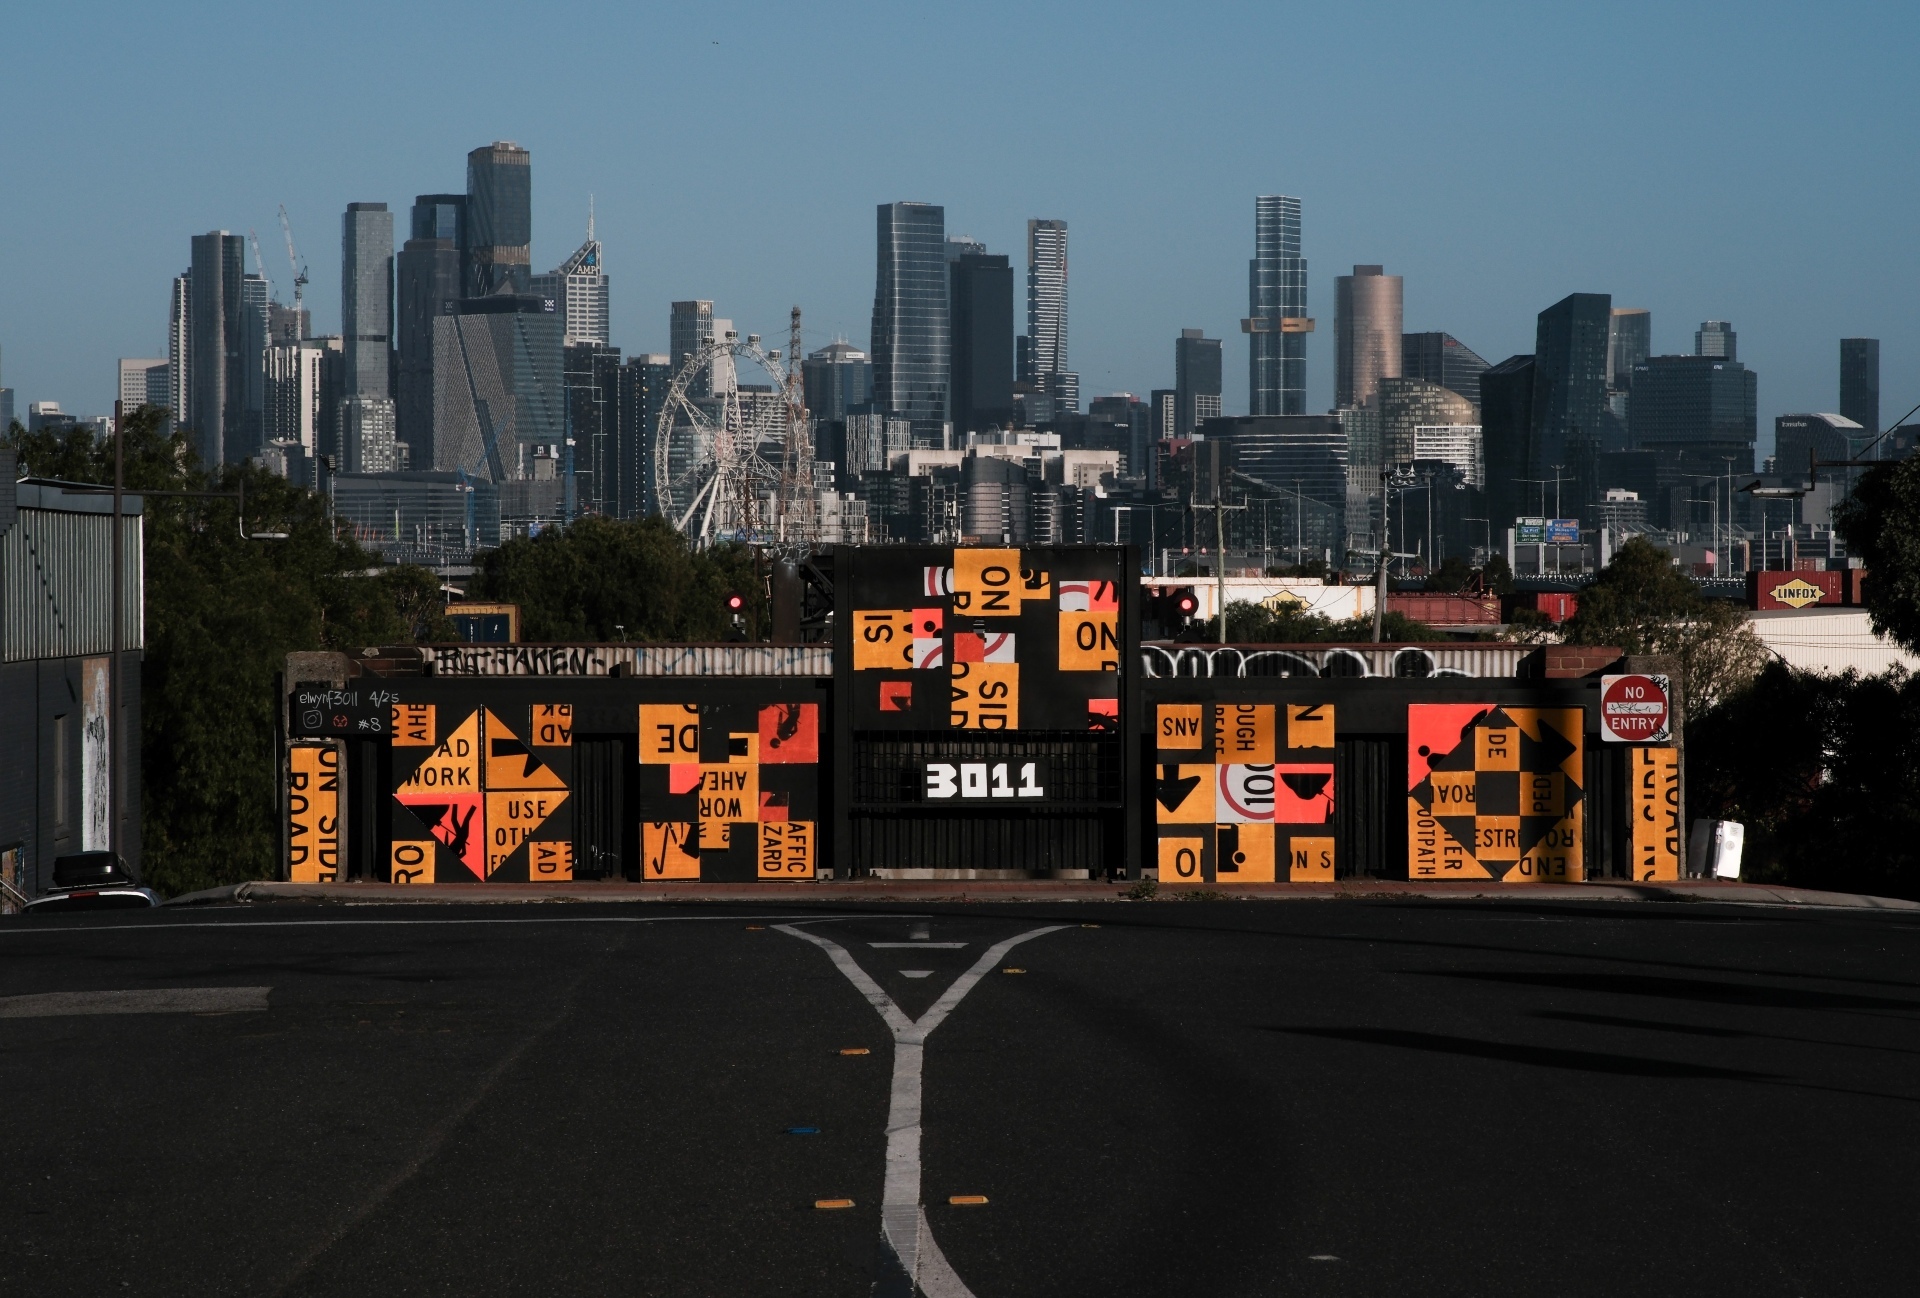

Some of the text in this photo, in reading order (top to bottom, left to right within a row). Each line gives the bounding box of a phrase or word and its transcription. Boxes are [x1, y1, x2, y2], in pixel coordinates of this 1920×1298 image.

[577, 265, 596, 274] AMP
[981, 566, 1010, 610] ON
[1778, 588, 1817, 599] LINFOX
[1077, 621, 1119, 650] ON
[369, 690, 400, 708] 4/25
[1625, 686, 1645, 699] NO
[979, 680, 1008, 730] SID
[358, 717, 382, 731] #8
[1612, 717, 1658, 730] ENTRY
[541, 724, 572, 743] AD
[657, 725, 698, 753] DE
[437, 739, 470, 757] AD
[1488, 734, 1507, 758] DE
[407, 767, 471, 786] WORK
[926, 762, 1044, 798] 3011
[508, 801, 548, 819] USE
[700, 798, 742, 817] WOR
[787, 823, 807, 873] AFFIC
[538, 843, 556, 873] AD
[1176, 848, 1203, 877] O
[1290, 851, 1308, 869] N
[1519, 857, 1566, 876] END
